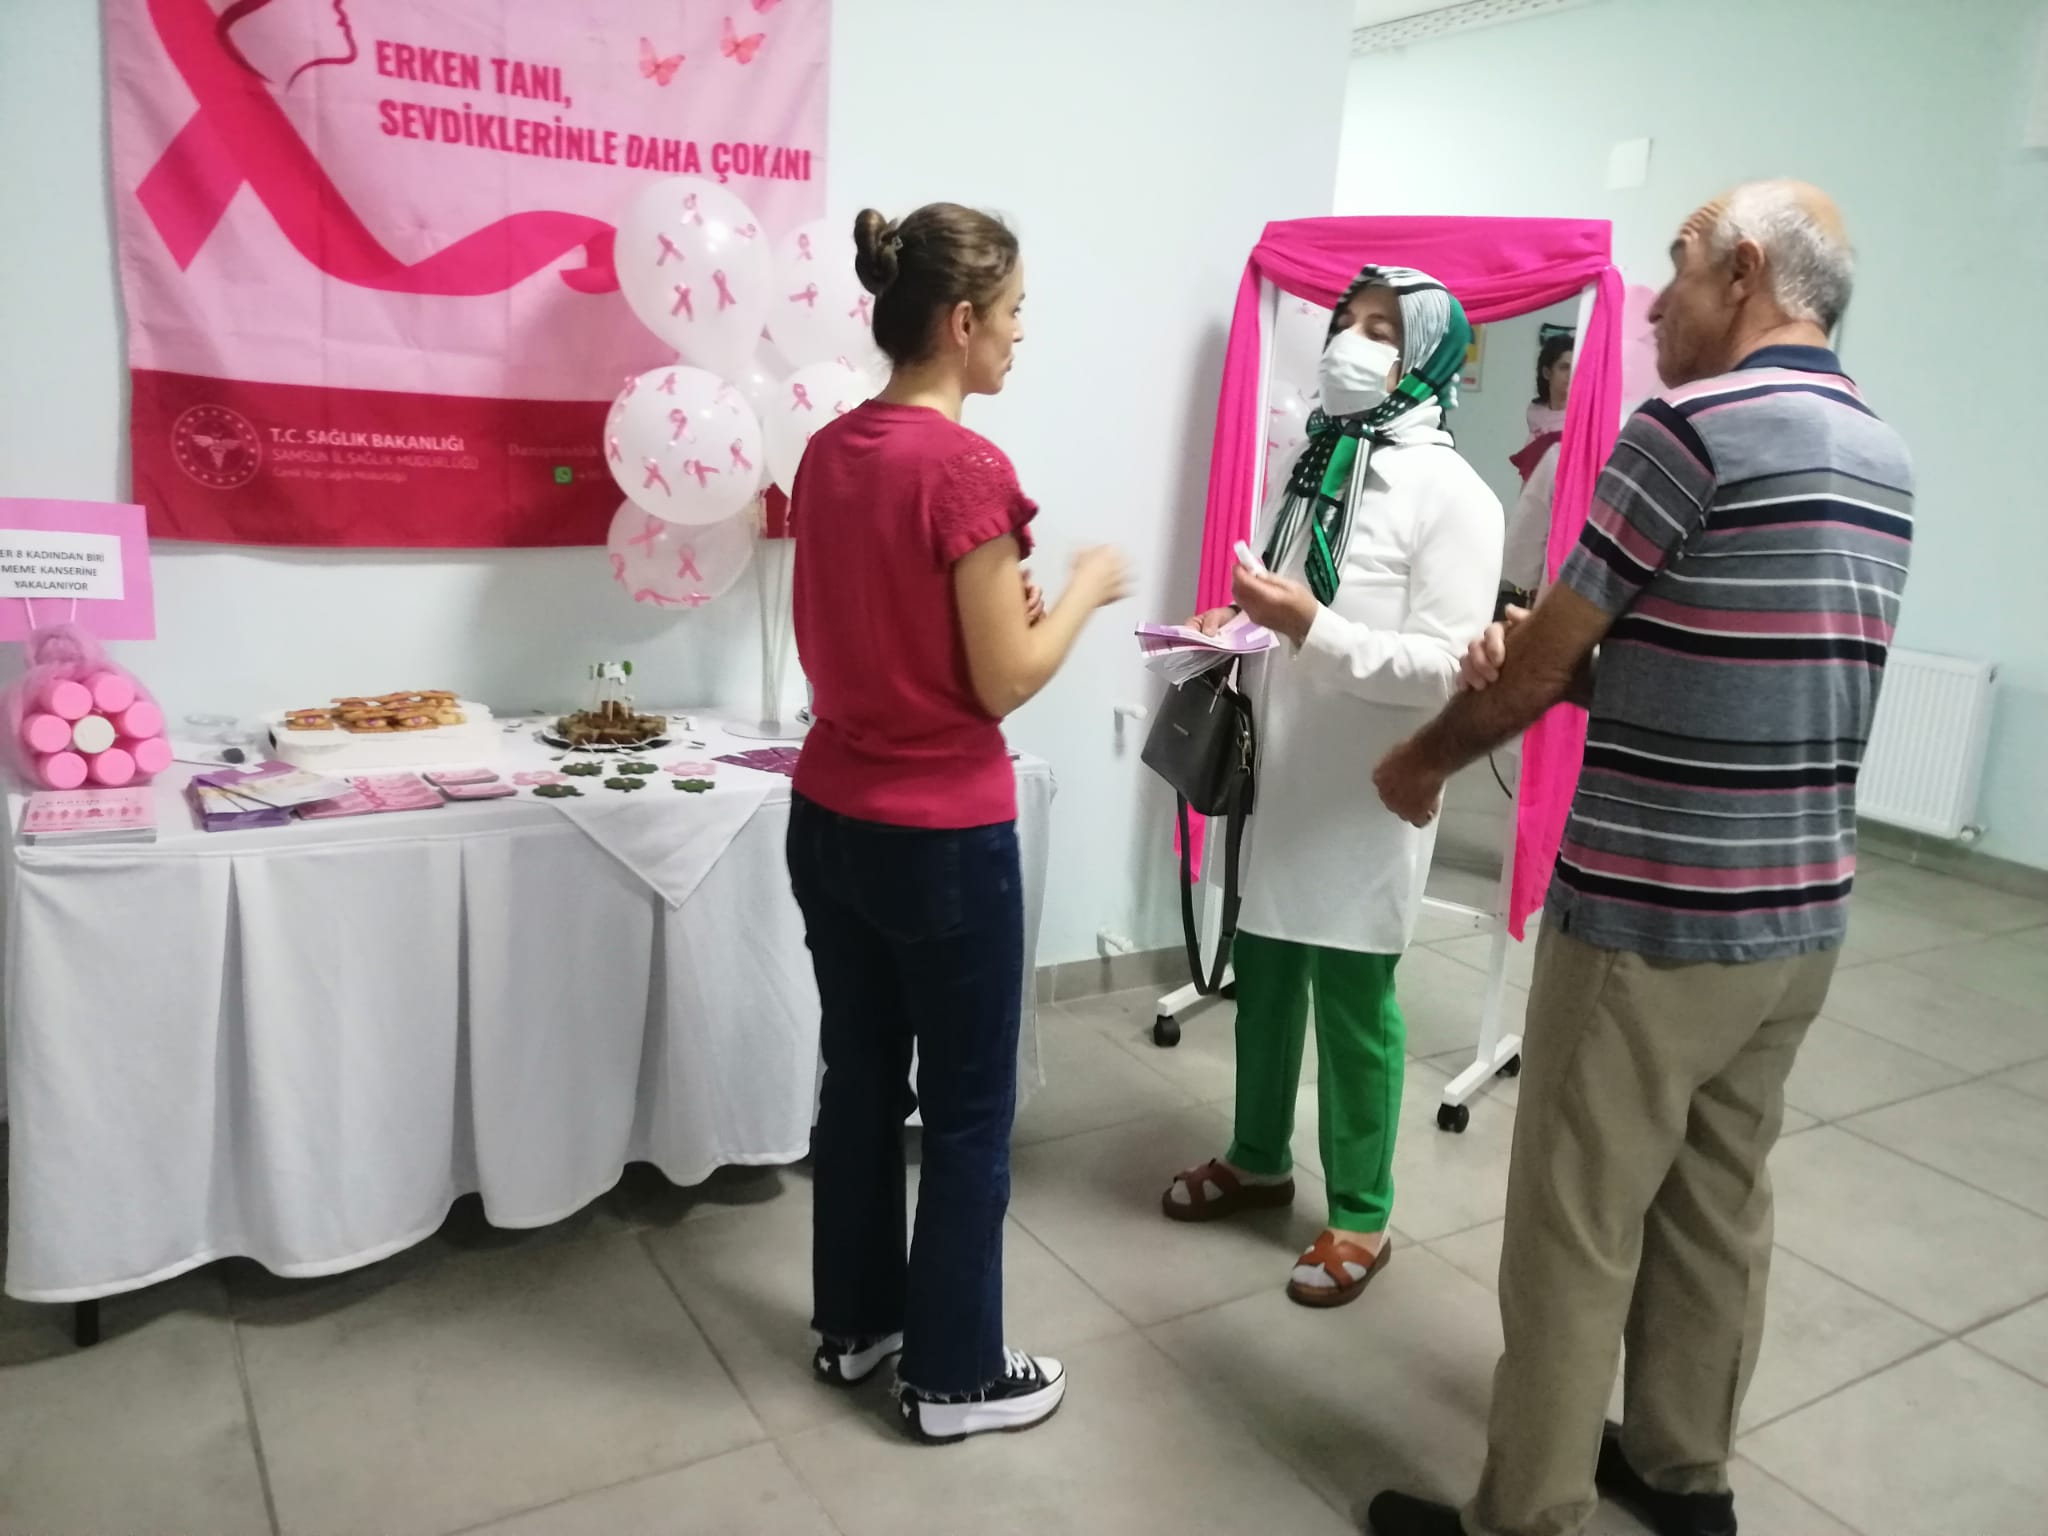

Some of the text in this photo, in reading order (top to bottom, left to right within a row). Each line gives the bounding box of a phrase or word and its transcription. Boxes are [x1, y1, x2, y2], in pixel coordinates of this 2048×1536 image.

[376, 40, 572, 109] ERKEN TANI,
[379, 99, 618, 165] SEVDİKLERİNLE
[626, 134, 702, 173] DAHA
[269, 428, 465, 451] T.C. SAĞLIK BAKANLIĞI
[0, 549, 13, 558] ER
[16, 550, 23, 559] 8
[26, 550, 84, 561] KADINDAN
[1, 564, 37, 574] MEME
[14, 580, 88, 591] YAKALANIYOR
